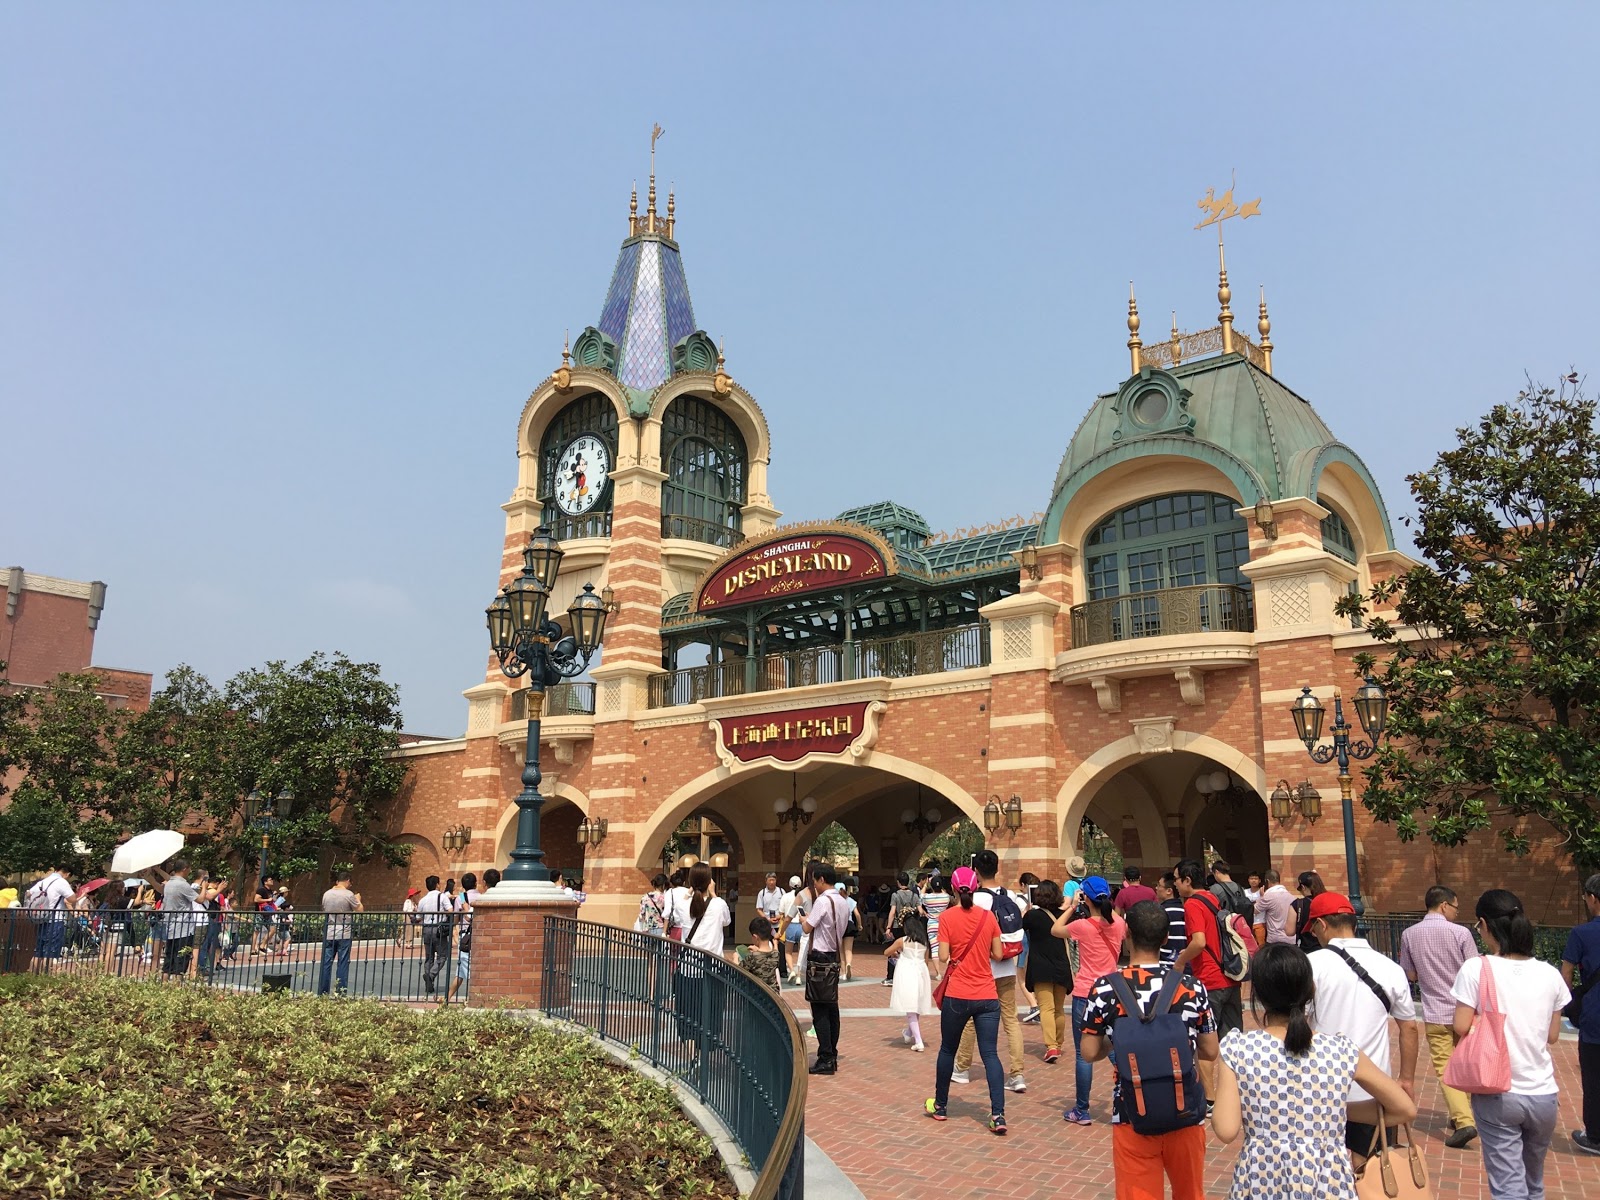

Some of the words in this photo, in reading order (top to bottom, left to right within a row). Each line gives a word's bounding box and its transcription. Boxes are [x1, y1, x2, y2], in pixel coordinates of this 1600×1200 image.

[578, 440, 586, 450] 12
[590, 442, 594, 450] 1
[570, 447, 575, 457] 11
[597, 450, 602, 460] 2
[560, 461, 568, 472] 10
[600, 464, 606, 474] 3
[557, 478, 562, 487] 9
[596, 480, 601, 490] 4
[560, 491, 564, 500] 8
[587, 494, 592, 504] 5
[567, 500, 572, 510] 7
[576, 502, 582, 511] 6
[763, 540, 811, 558] SHANGHAI
[724, 552, 852, 596] DISNEYLAND
[727, 715, 853, 746] 上海迪士尼乐园
